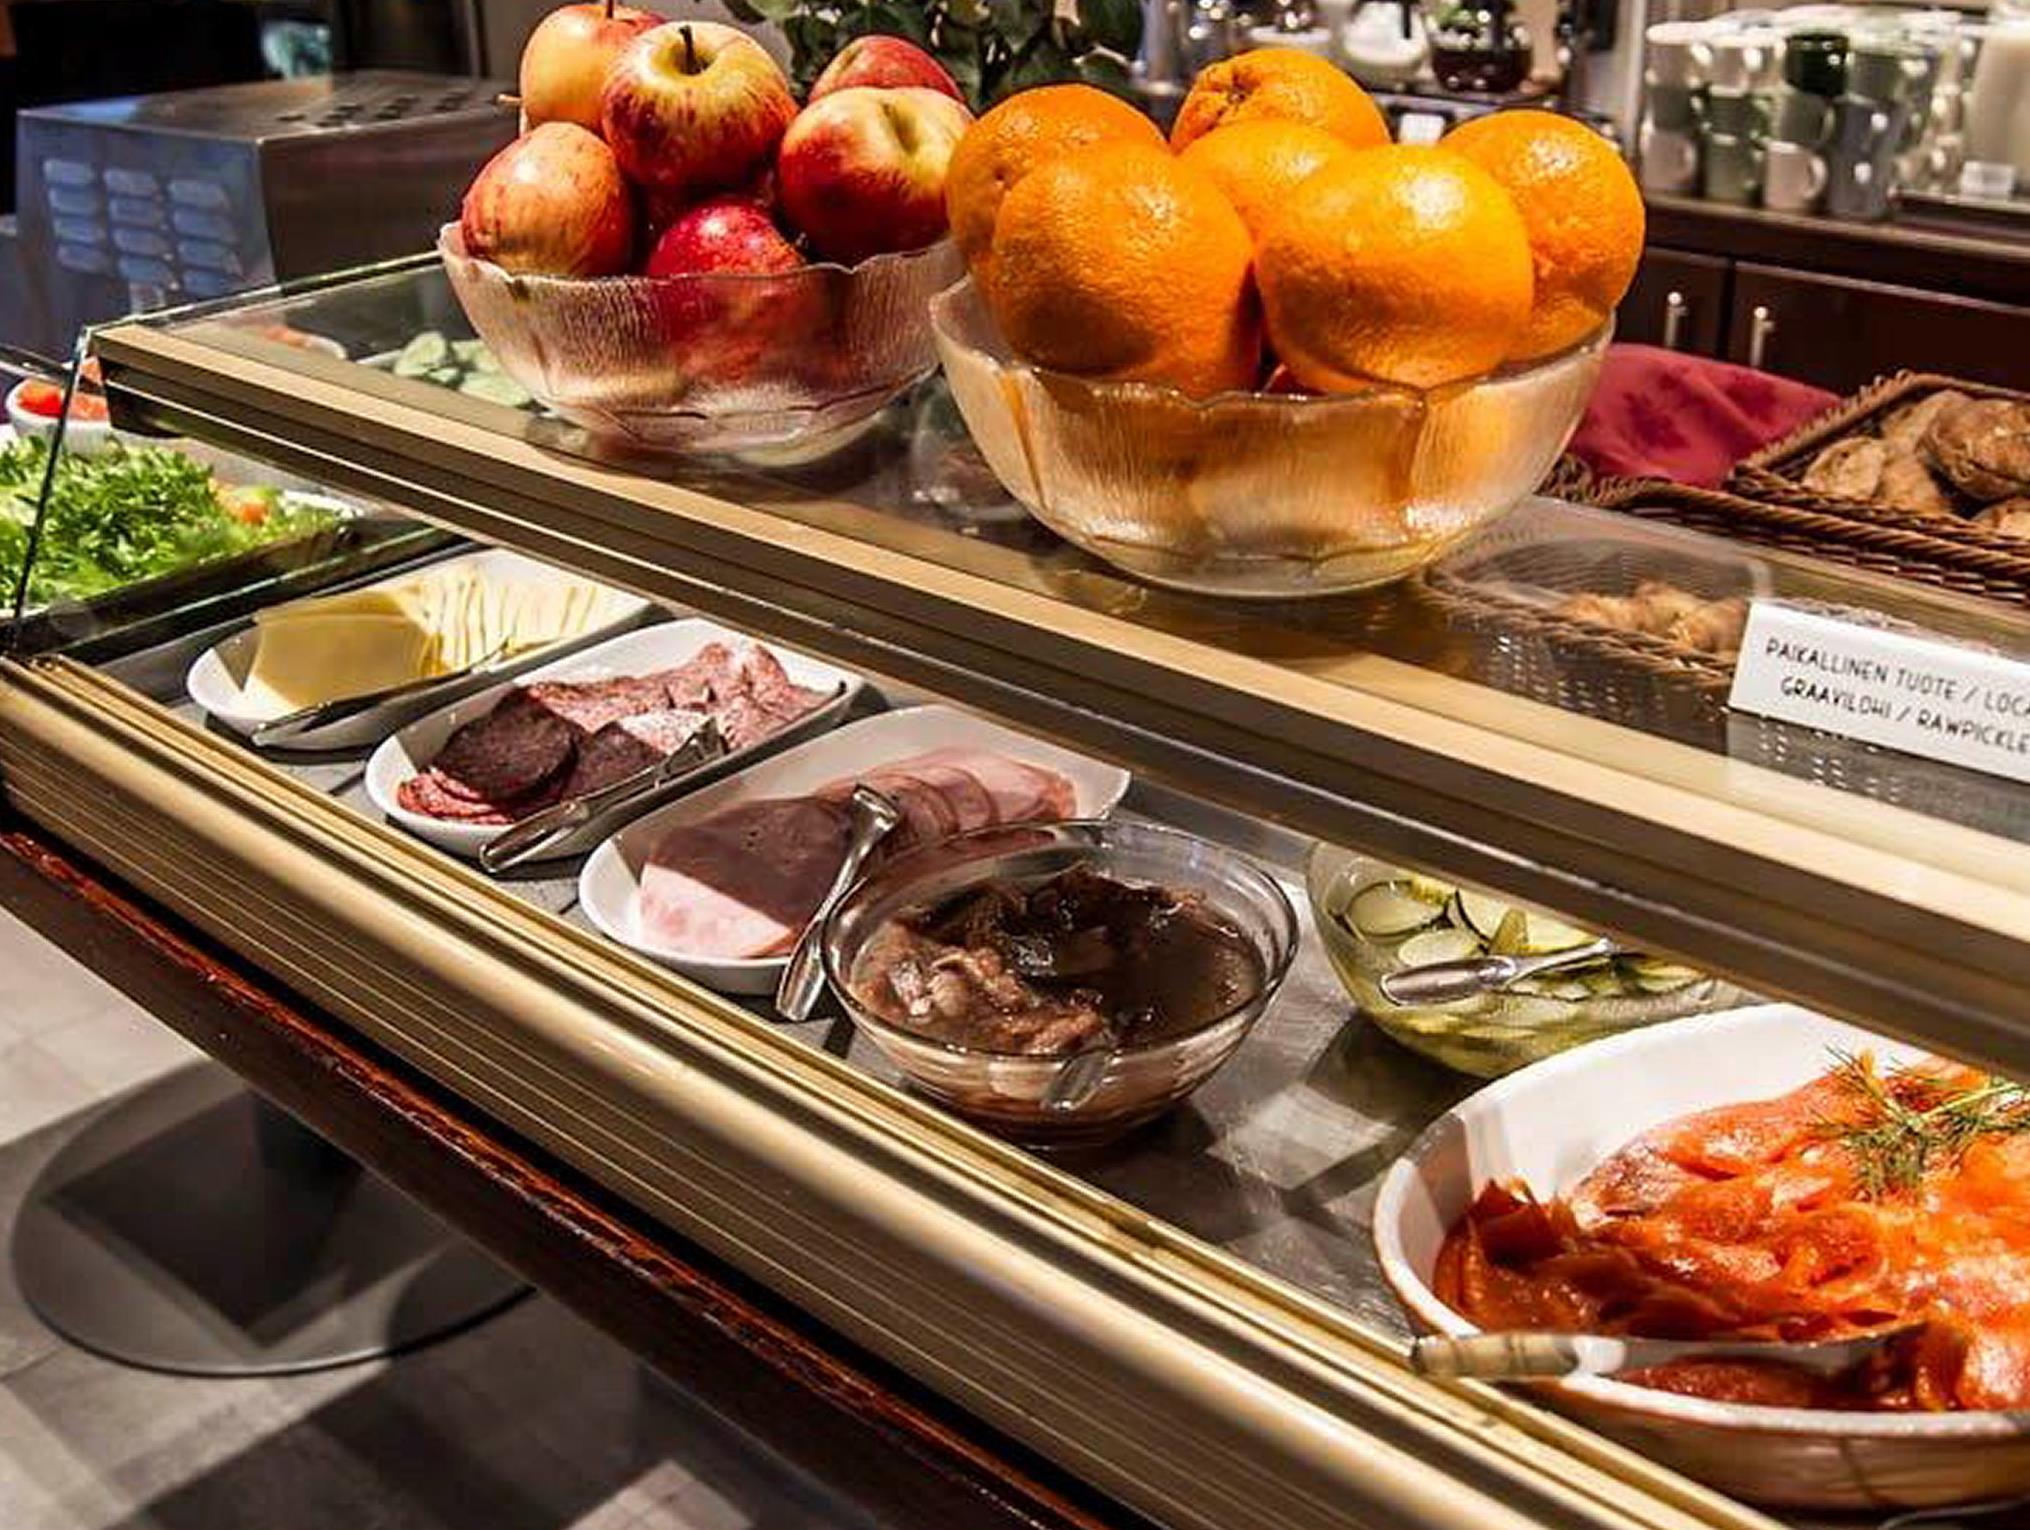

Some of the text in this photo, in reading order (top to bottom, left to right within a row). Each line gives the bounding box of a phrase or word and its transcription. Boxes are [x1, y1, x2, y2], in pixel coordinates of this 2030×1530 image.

[1766, 637, 1888, 682] PAIKALLINEN
[1896, 667, 1957, 699] TUOTE
[1962, 685, 1979, 703] /
[1896, 706, 1911, 721] /
